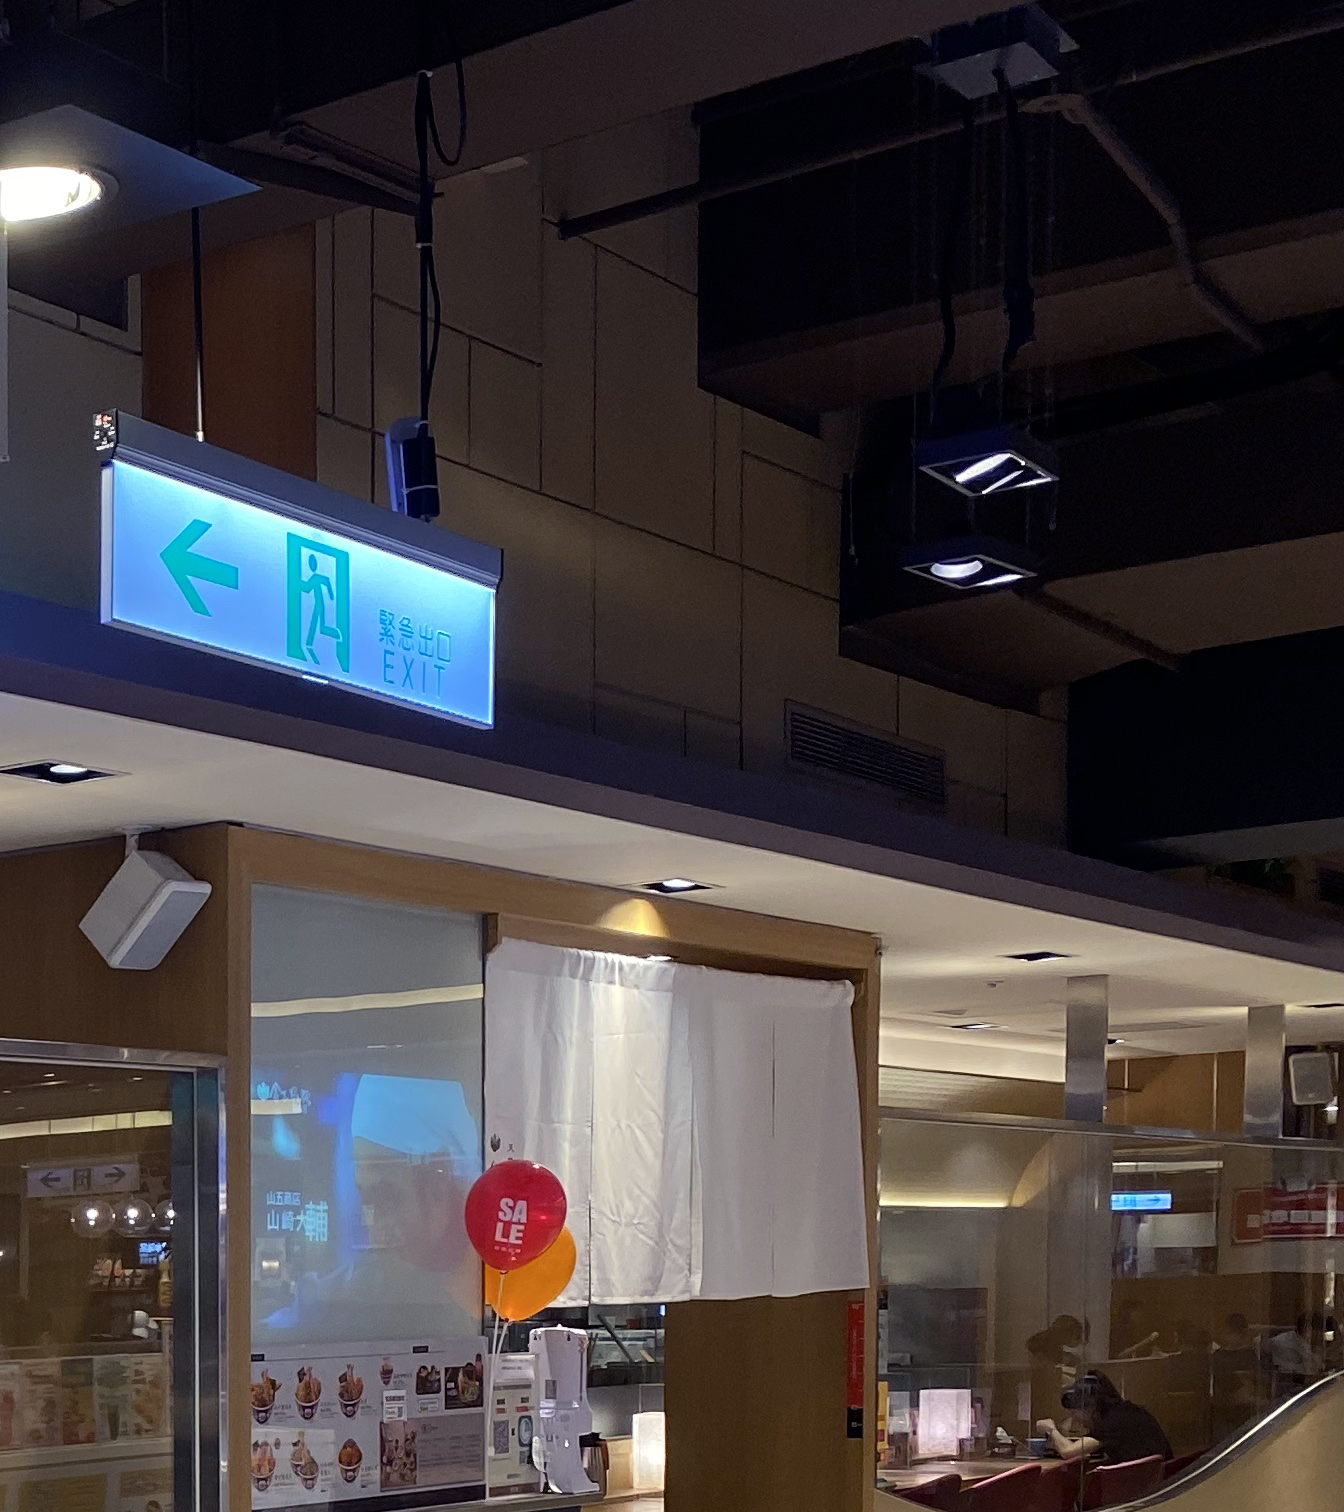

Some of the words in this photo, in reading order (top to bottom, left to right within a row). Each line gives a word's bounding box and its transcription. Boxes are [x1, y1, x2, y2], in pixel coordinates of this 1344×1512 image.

[378, 608, 452, 663] 緊急出口
[383, 649, 446, 699] EXIT
